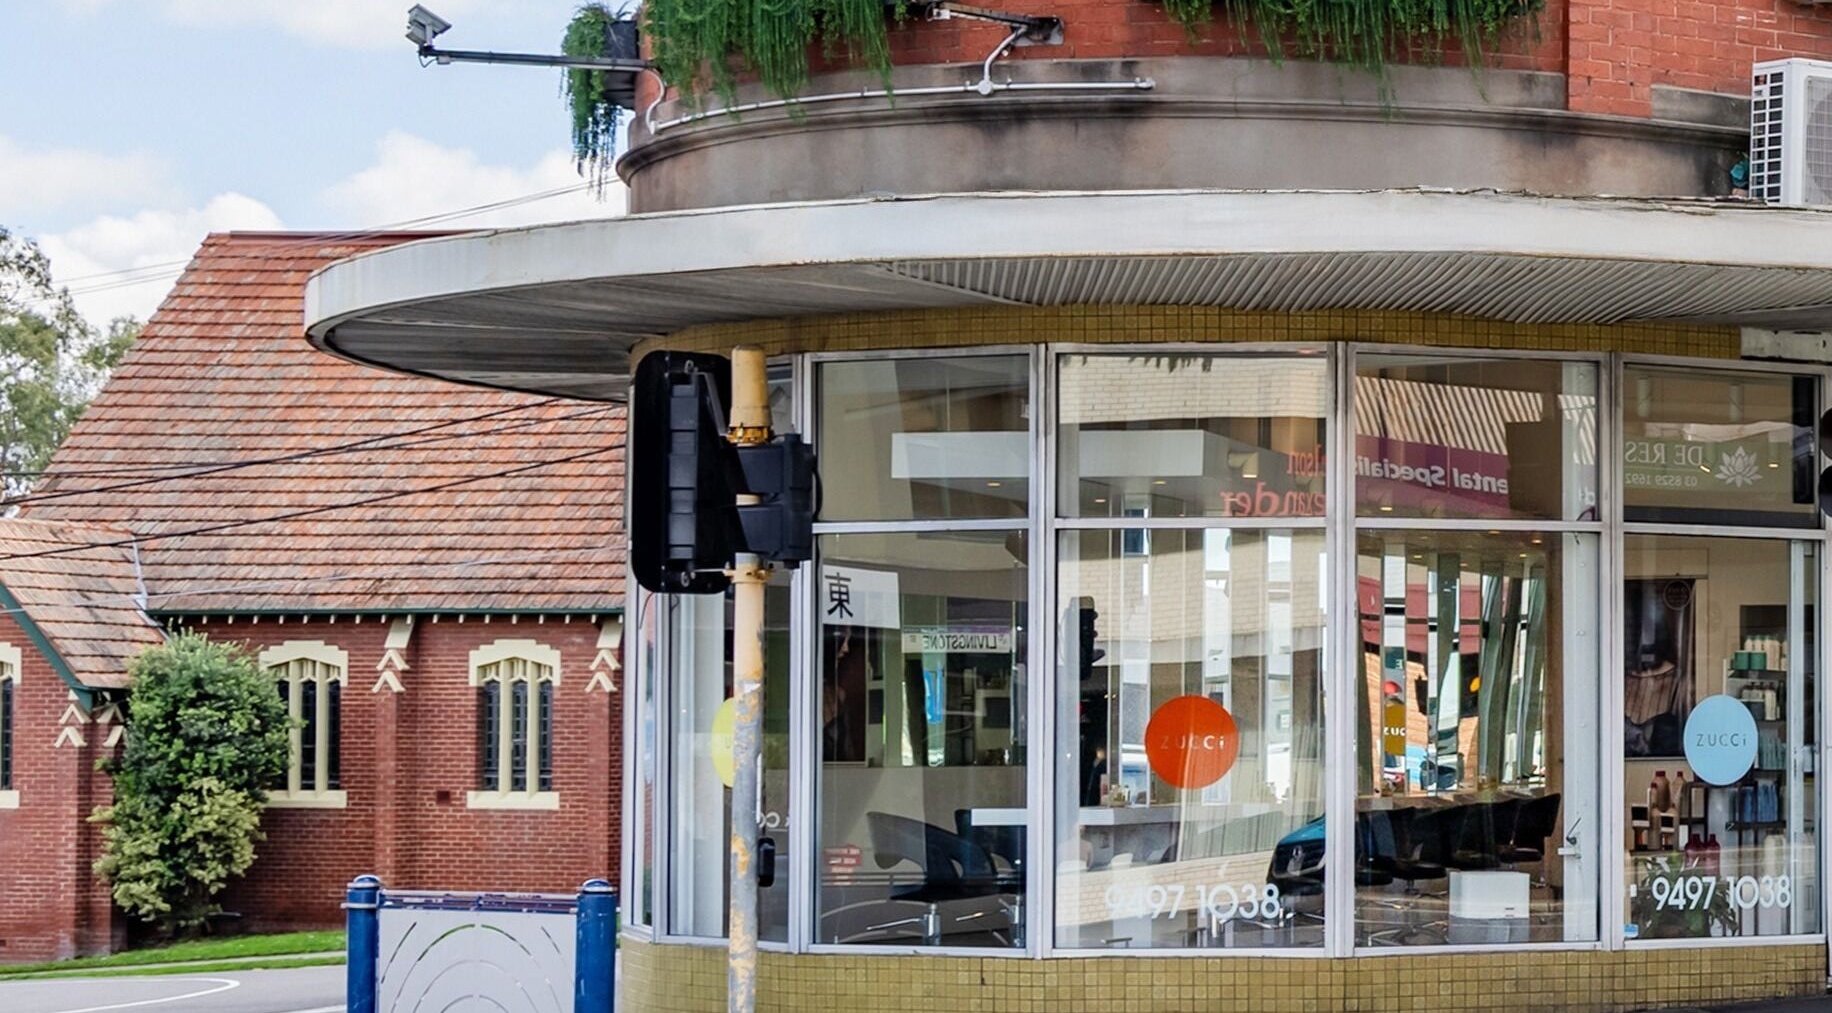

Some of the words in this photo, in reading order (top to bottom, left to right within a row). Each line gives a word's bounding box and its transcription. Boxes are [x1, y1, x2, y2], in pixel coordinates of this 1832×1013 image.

[824, 573, 853, 619] 東
[1105, 884, 1185, 920] 9497
[1195, 883, 1281, 920] 1038
[1652, 876, 1716, 911] 9497
[1726, 875, 1792, 909] 1038
